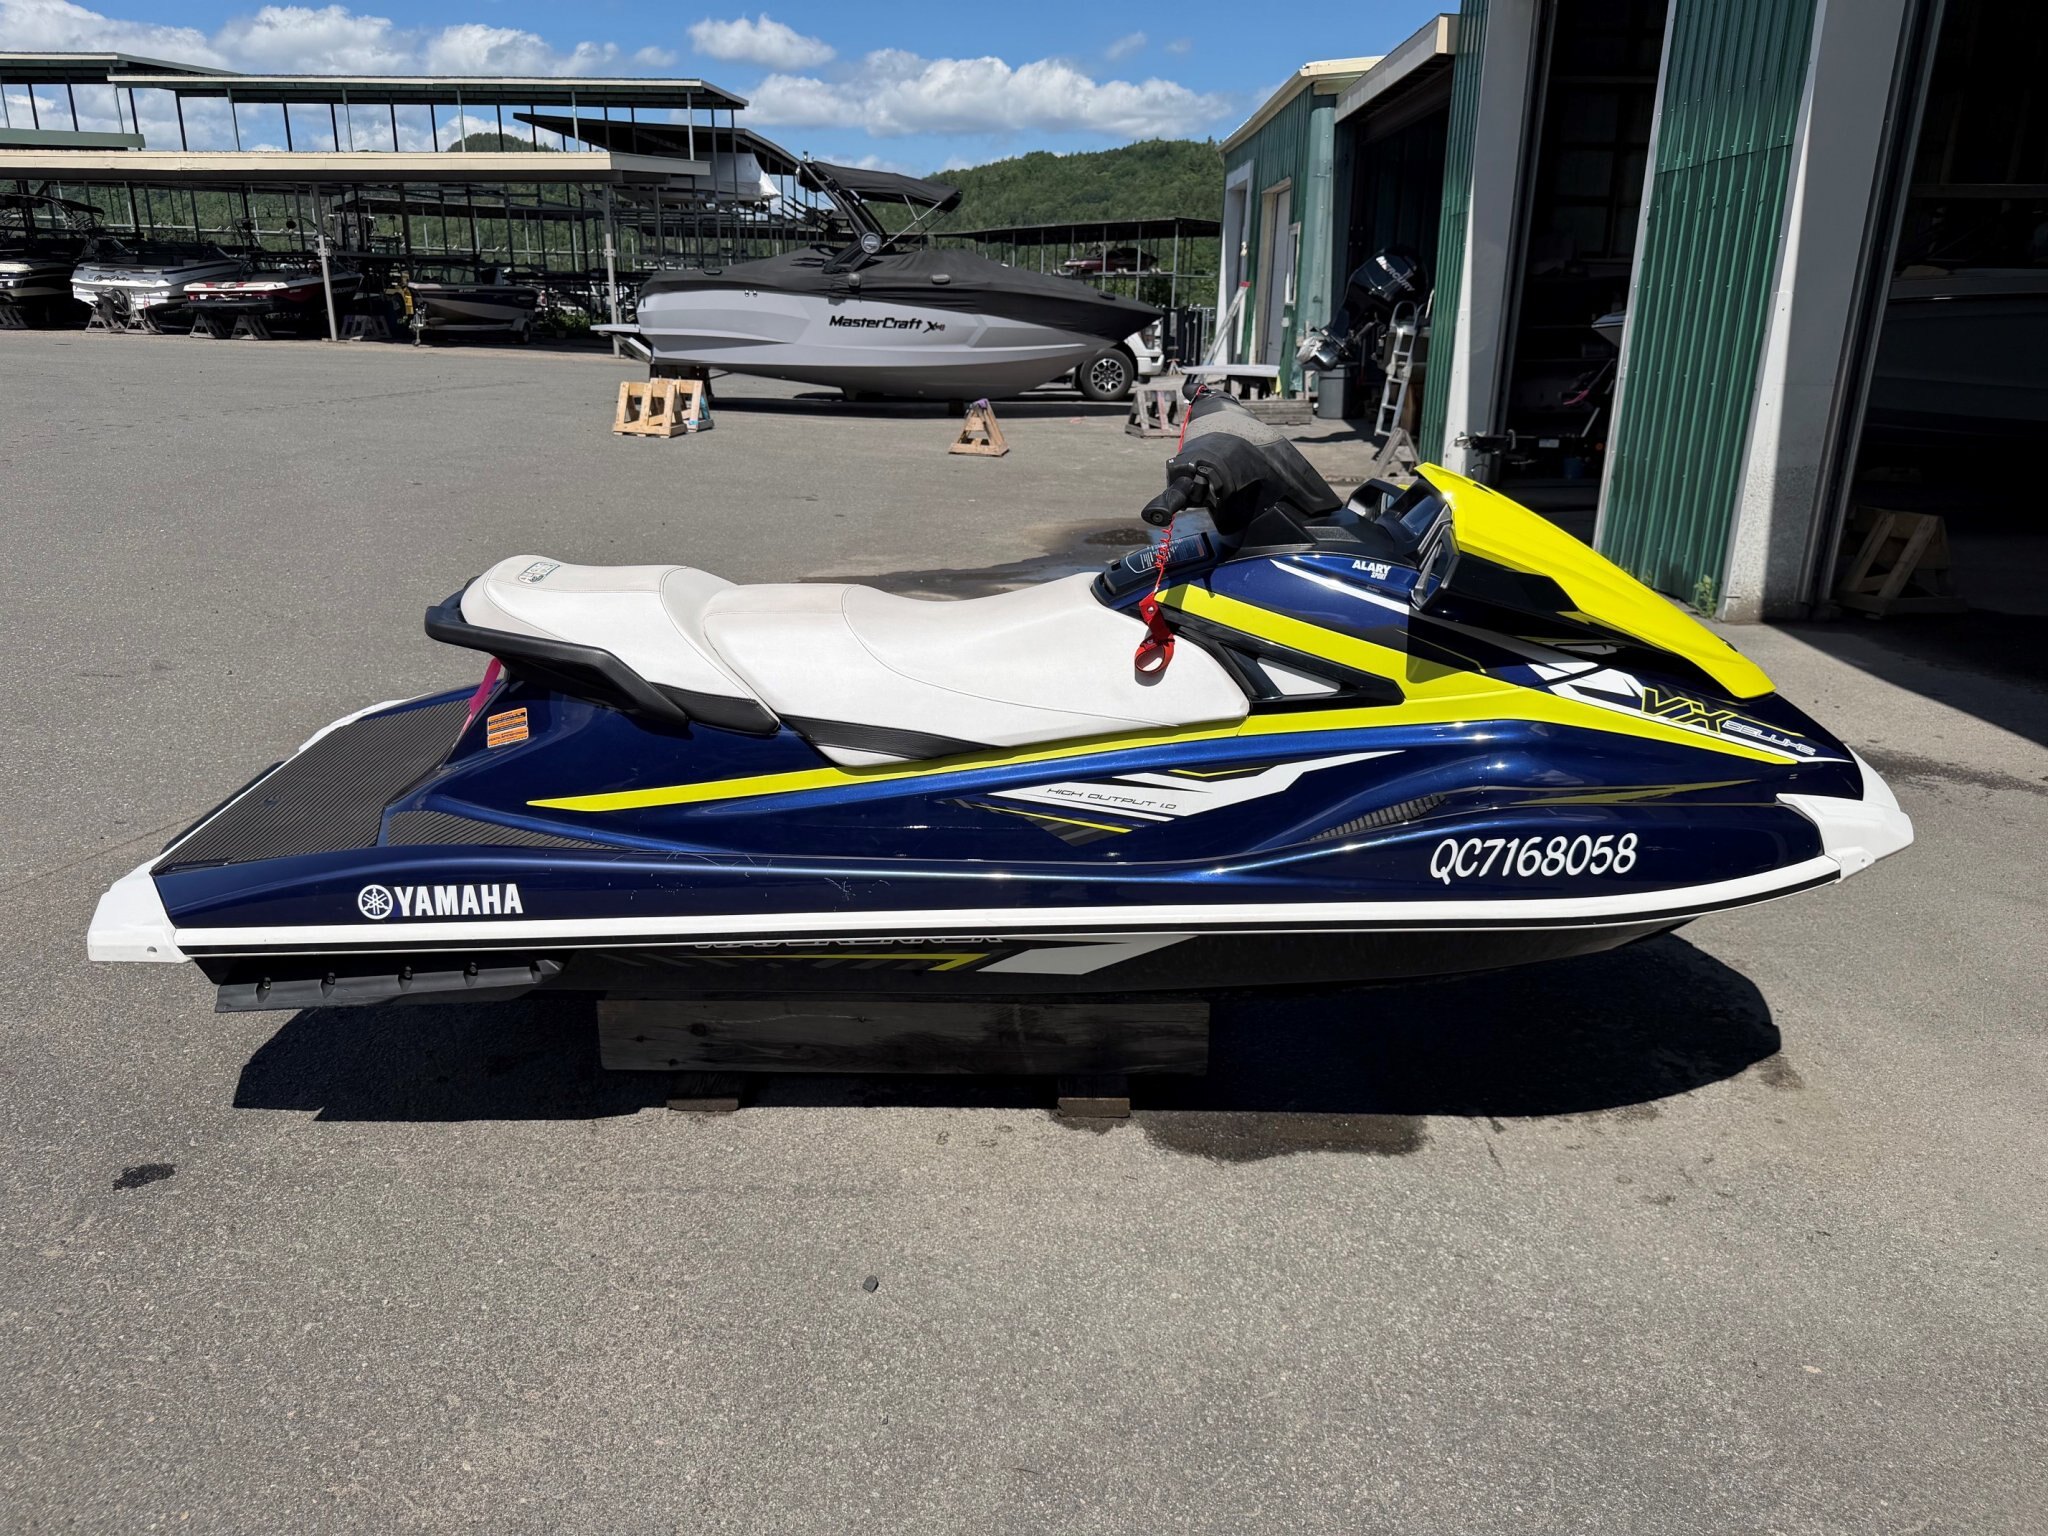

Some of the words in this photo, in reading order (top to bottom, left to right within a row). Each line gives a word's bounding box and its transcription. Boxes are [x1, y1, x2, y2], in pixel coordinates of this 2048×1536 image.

[1376, 255, 1415, 291] MERCURY
[829, 315, 923, 330] MasterCraft
[1351, 560, 1391, 574] ALARY
[1371, 571, 1388, 581] SPORT
[1641, 687, 1738, 735] VX
[1722, 719, 1816, 756] DELUXE
[1046, 787, 1084, 798] HIGH
[1087, 793, 1156, 807] OUTPUT
[1159, 802, 1177, 810] 1.0
[1430, 832, 1638, 885] QC7168058
[394, 883, 524, 917] YAMAHA
